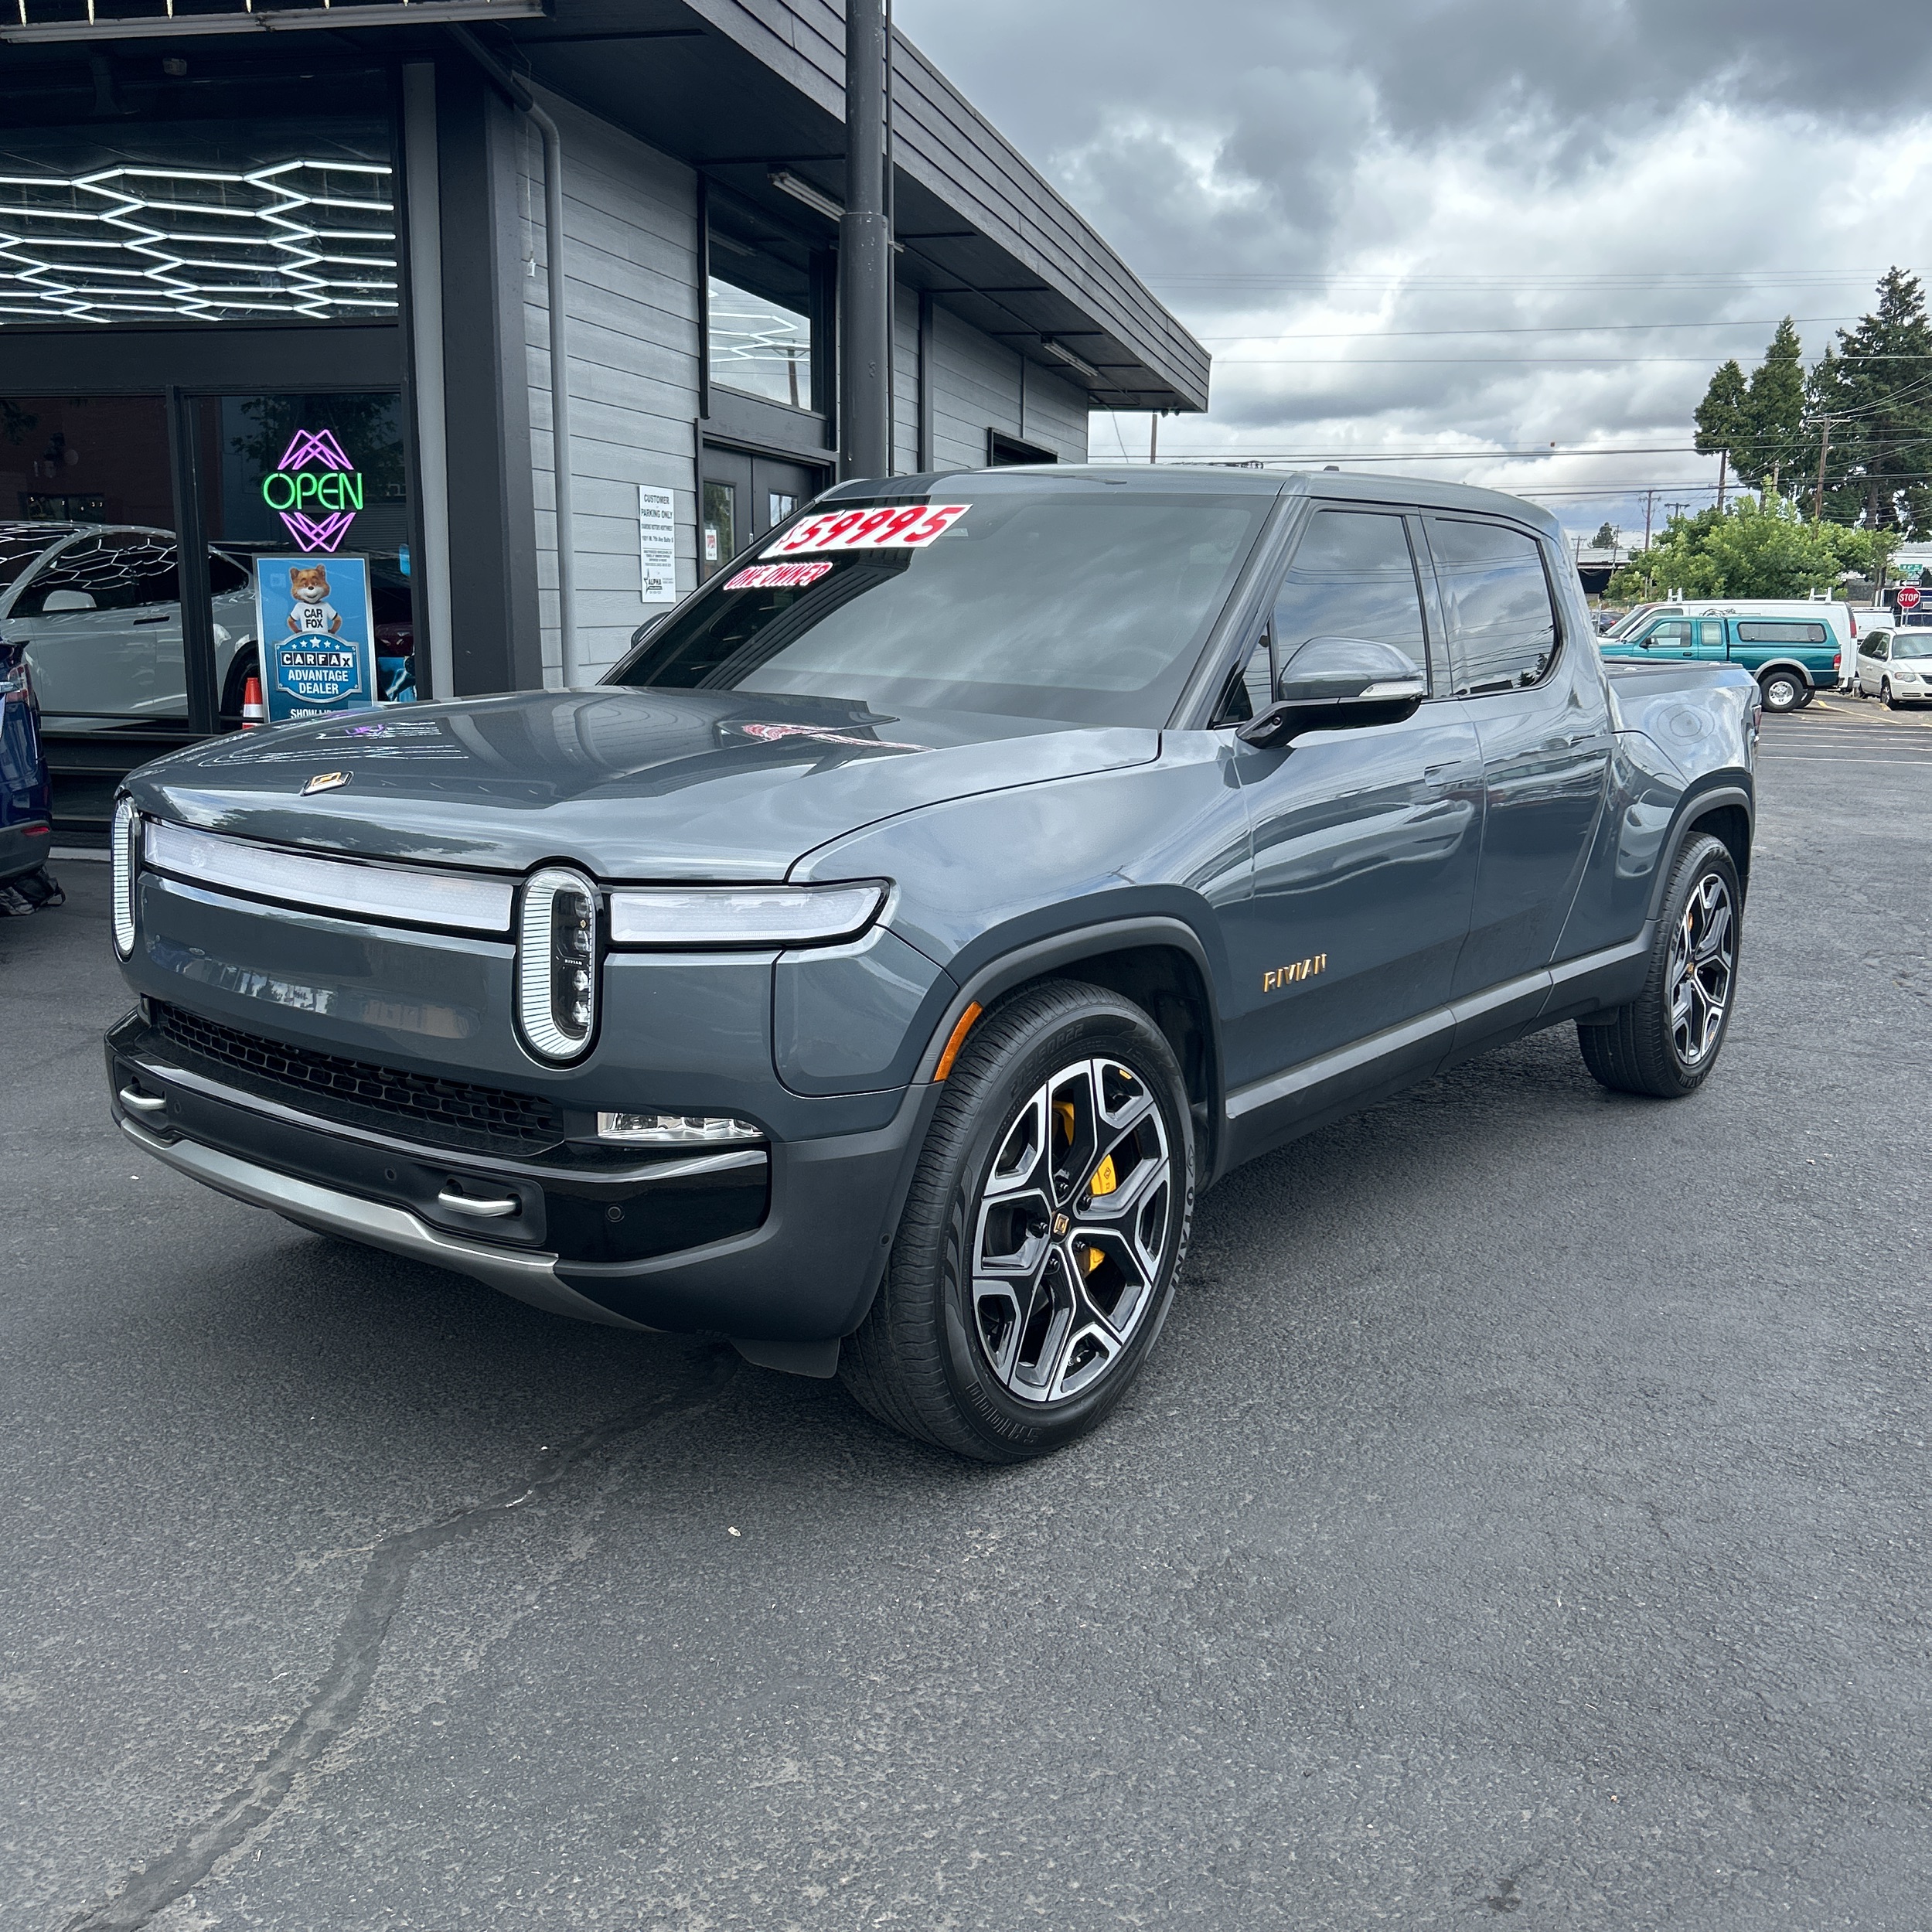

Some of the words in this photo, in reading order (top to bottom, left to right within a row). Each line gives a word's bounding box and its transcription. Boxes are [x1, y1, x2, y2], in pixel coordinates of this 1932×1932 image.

[263, 472, 363, 509] OPEN
[644, 494, 670, 504] CUSTOMER
[641, 509, 660, 518] PARKING
[661, 510, 673, 519] ONLY
[726, 566, 772, 588] ONE
[758, 564, 830, 586] OWNER
[1899, 593, 1919, 602] STOP
[304, 608, 323, 618] CAR
[305, 619, 323, 628] FOX
[282, 653, 351, 666] CARFAX
[288, 670, 349, 681] ADVANTAGE
[298, 683, 339, 694] DEALER
[1262, 952, 1327, 993] RIVIAN
